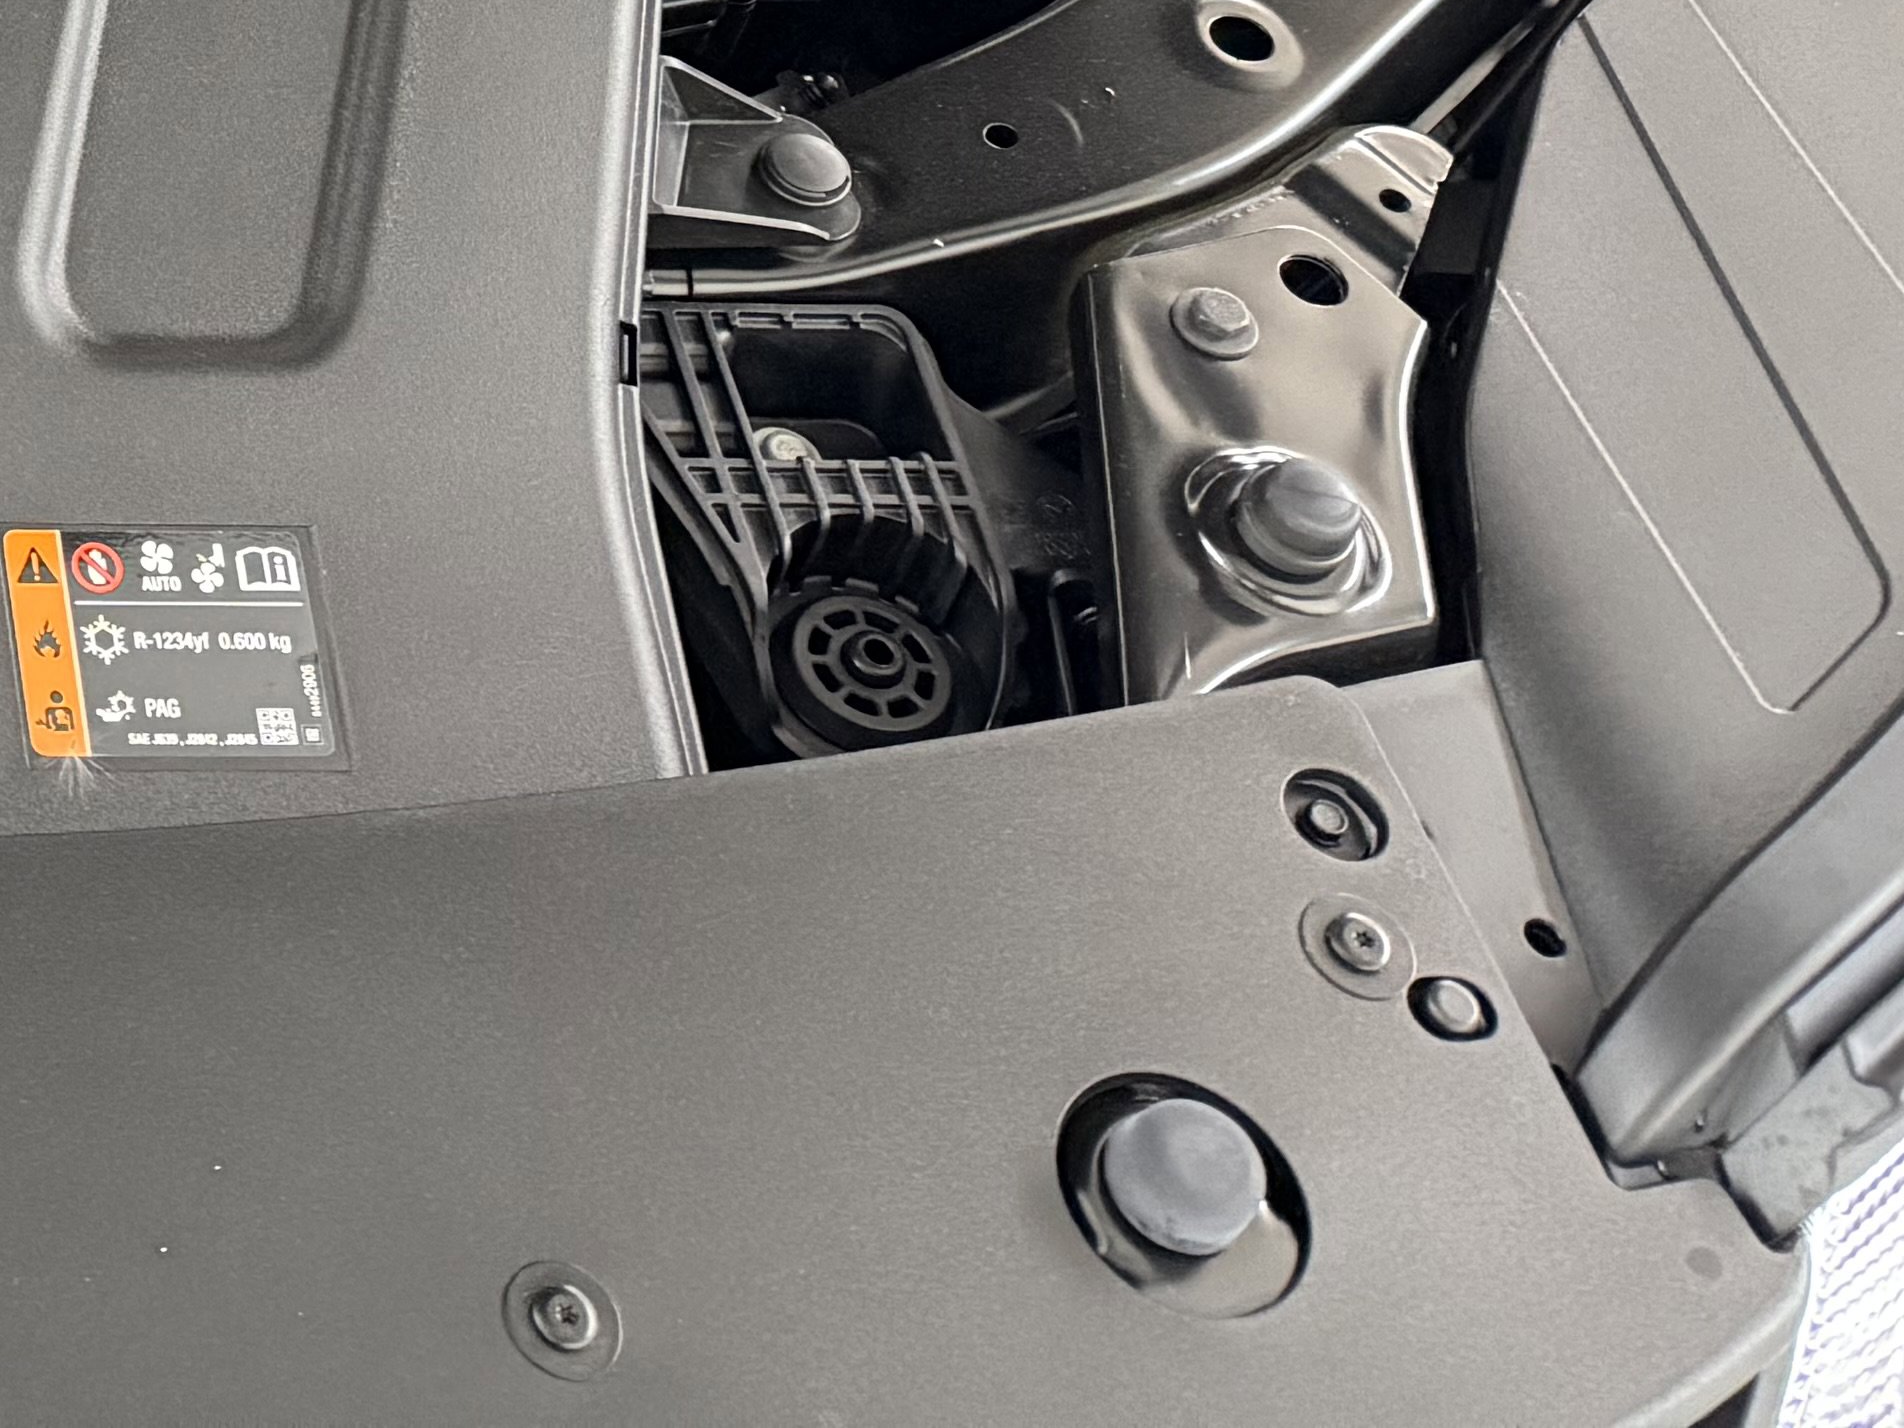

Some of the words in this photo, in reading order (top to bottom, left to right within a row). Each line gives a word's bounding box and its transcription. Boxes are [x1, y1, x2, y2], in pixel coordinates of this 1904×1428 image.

[141, 574, 182, 593] AUTO
[133, 631, 210, 655] R-1234yf
[218, 632, 267, 652] 0.600
[269, 632, 292, 655] kg
[144, 697, 182, 719] PAG
